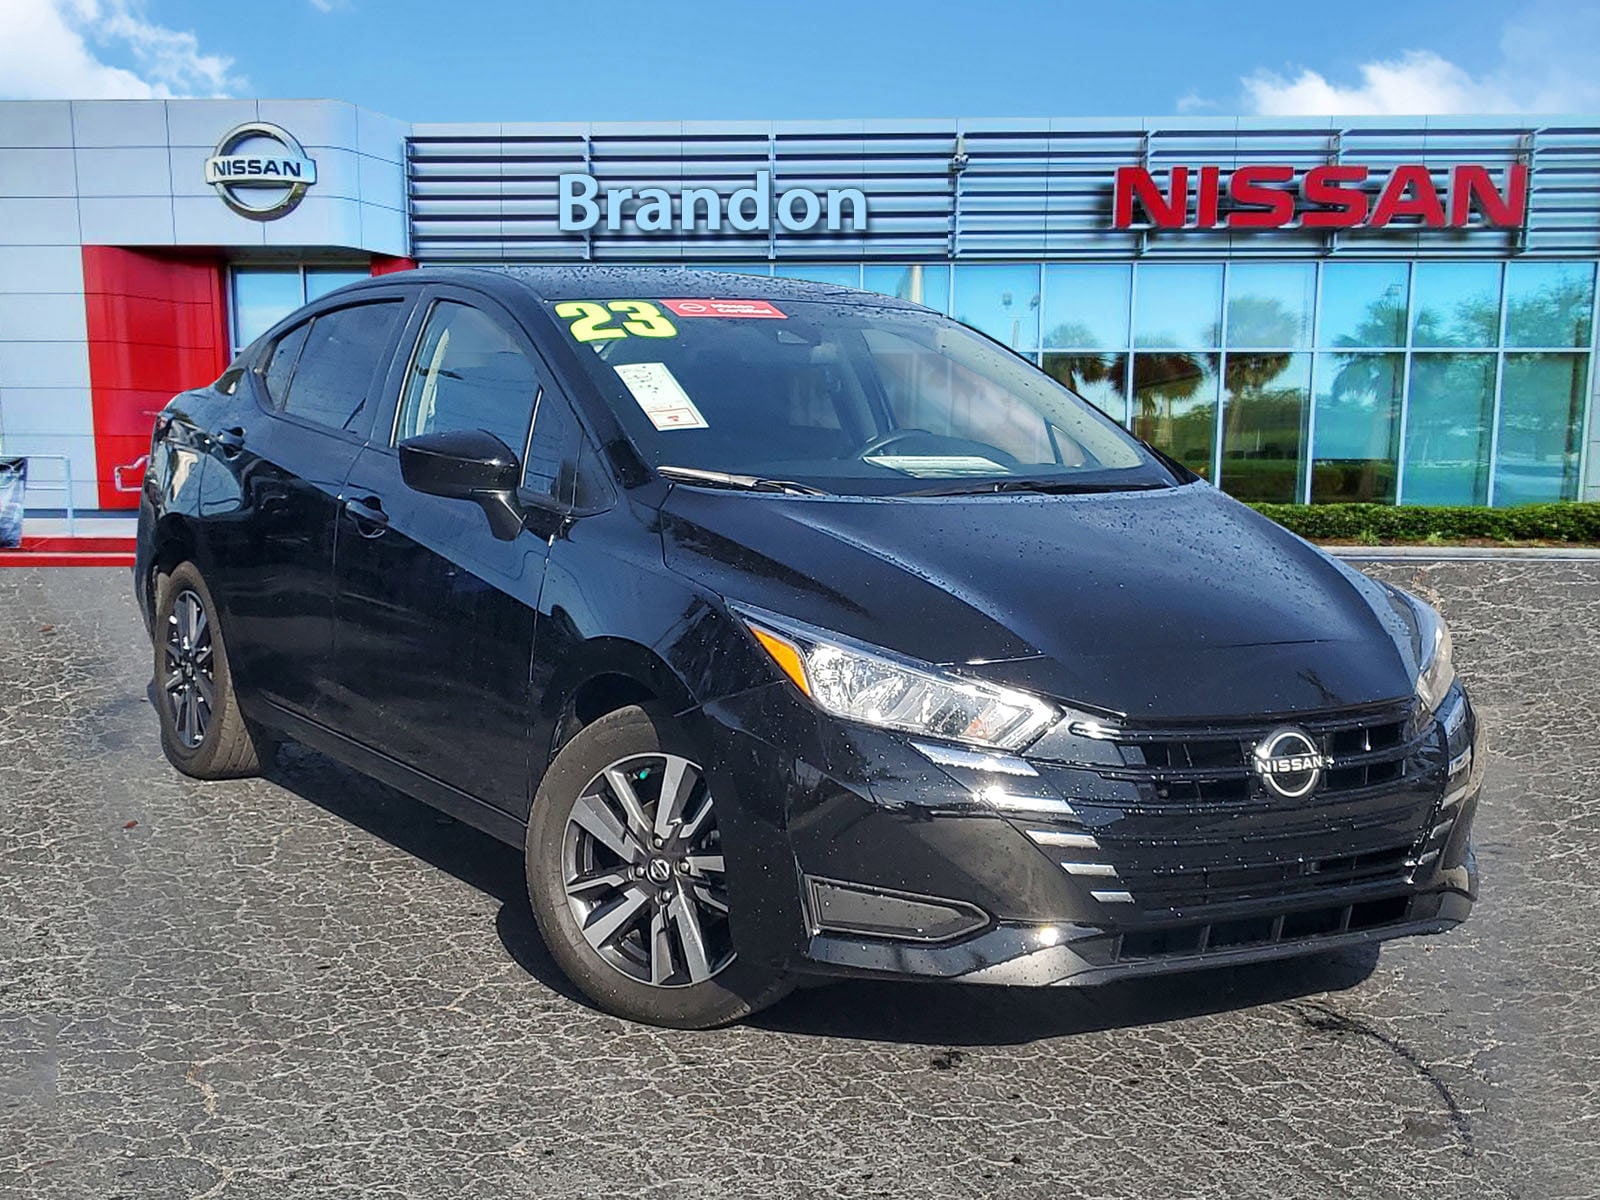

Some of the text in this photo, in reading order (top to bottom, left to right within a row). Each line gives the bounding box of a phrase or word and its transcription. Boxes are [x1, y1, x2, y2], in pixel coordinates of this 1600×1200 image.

[213, 159, 301, 177] NISSAN
[559, 165, 1529, 230] Brandon NISSAN
[554, 300, 678, 342] 23
[1257, 755, 1323, 773] NISSAN
